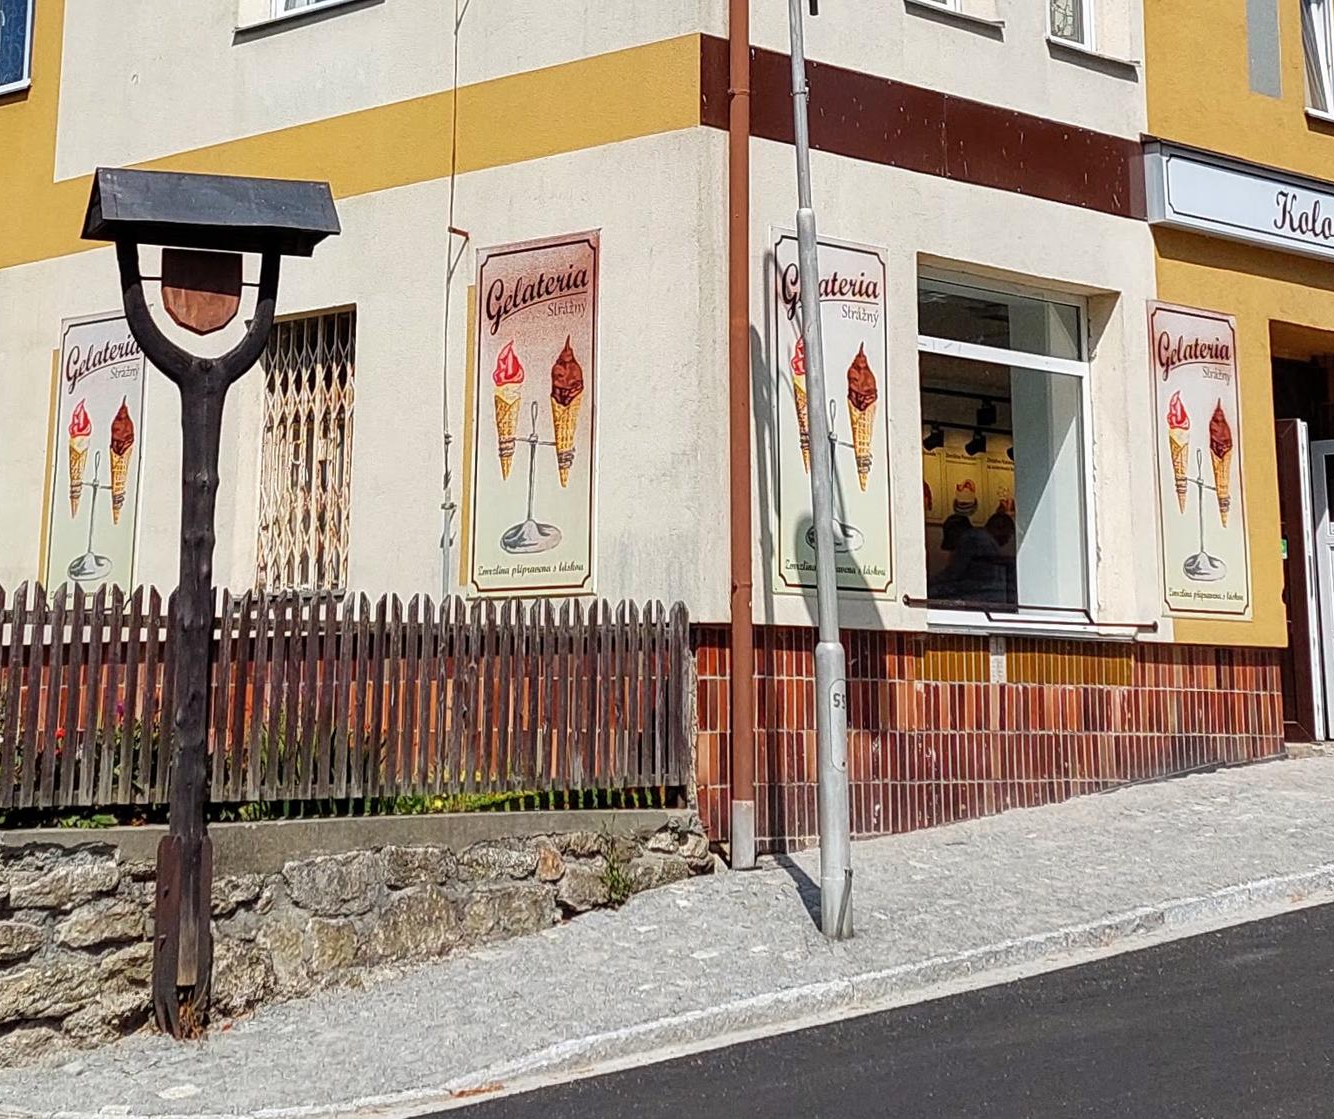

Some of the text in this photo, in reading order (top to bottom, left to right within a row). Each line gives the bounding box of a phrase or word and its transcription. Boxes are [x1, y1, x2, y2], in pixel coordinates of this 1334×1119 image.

[486, 264, 589, 336] Gelateria
[782, 263, 880, 320] Gateria
[841, 304, 879, 328] Strážný
[66, 334, 141, 394] Gelateria
[1158, 331, 1231, 381] Gelateria
